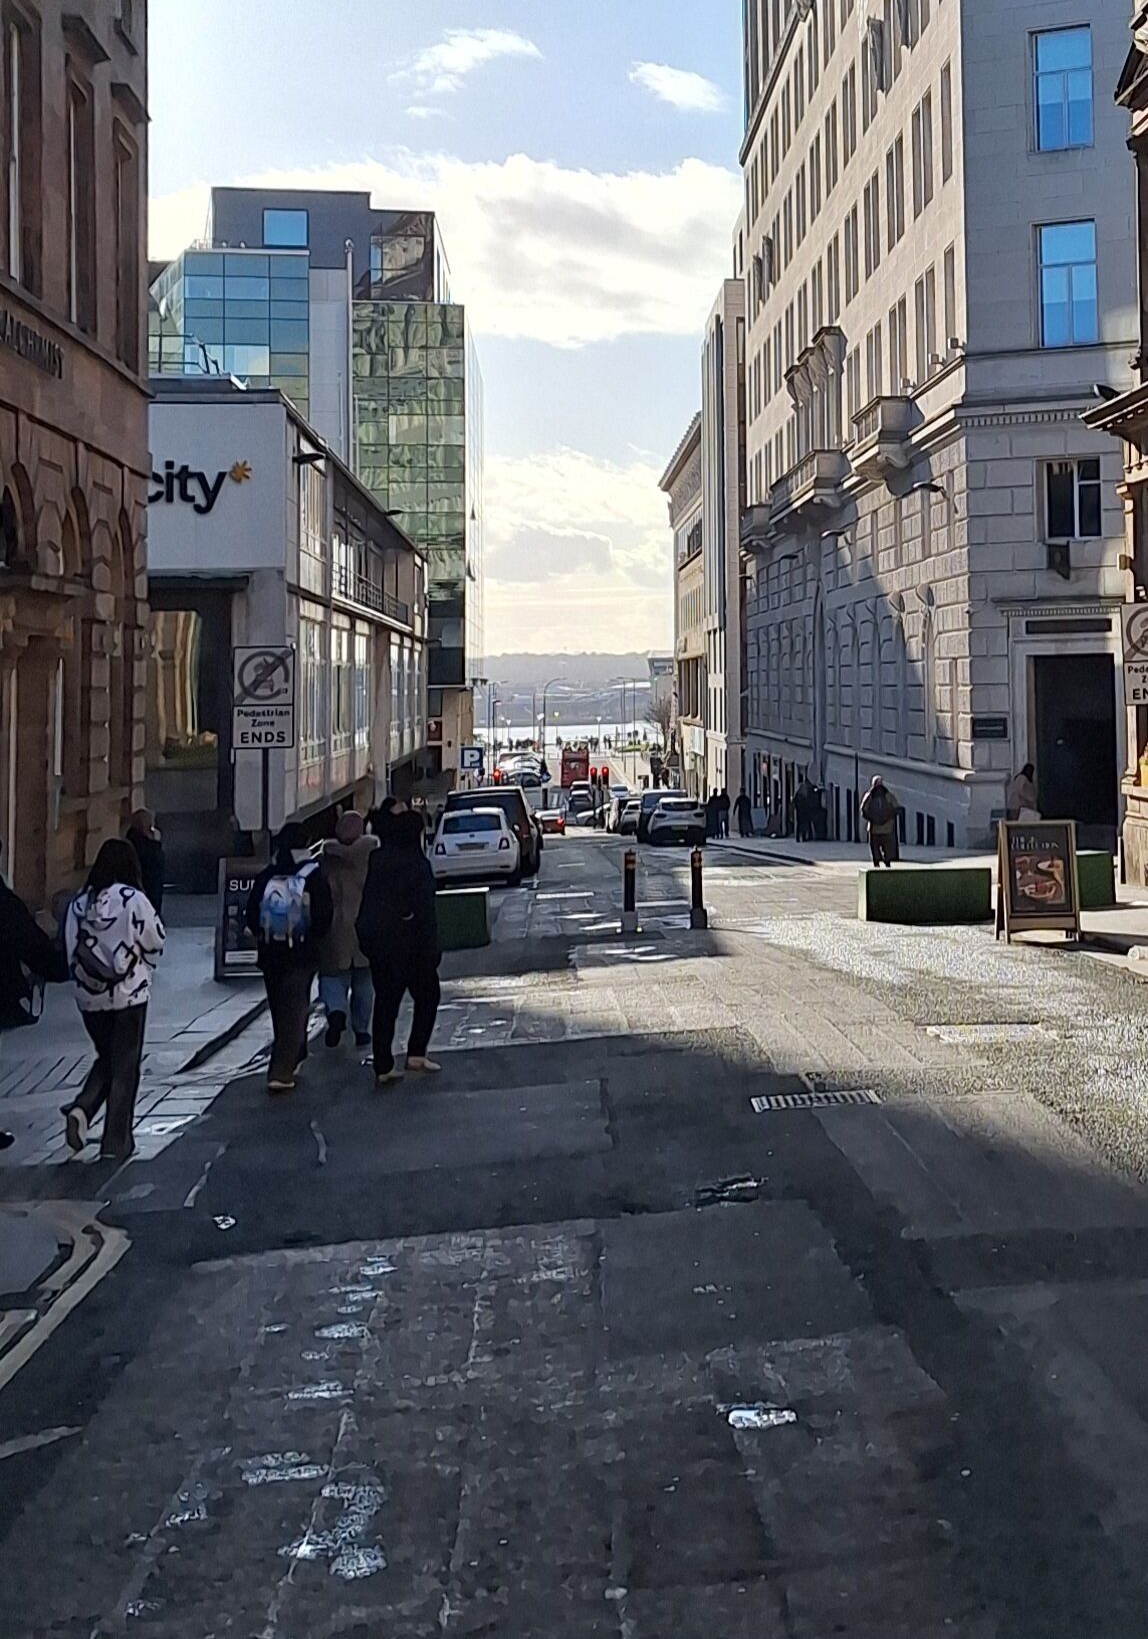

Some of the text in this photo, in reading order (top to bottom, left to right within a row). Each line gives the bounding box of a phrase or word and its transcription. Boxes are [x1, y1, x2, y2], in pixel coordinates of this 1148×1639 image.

[148, 460, 228, 515] city
[237, 708, 290, 717] Pedestrian
[251, 718, 275, 728] Zone
[240, 731, 286, 744] ENDS
[463, 749, 480, 767] P
